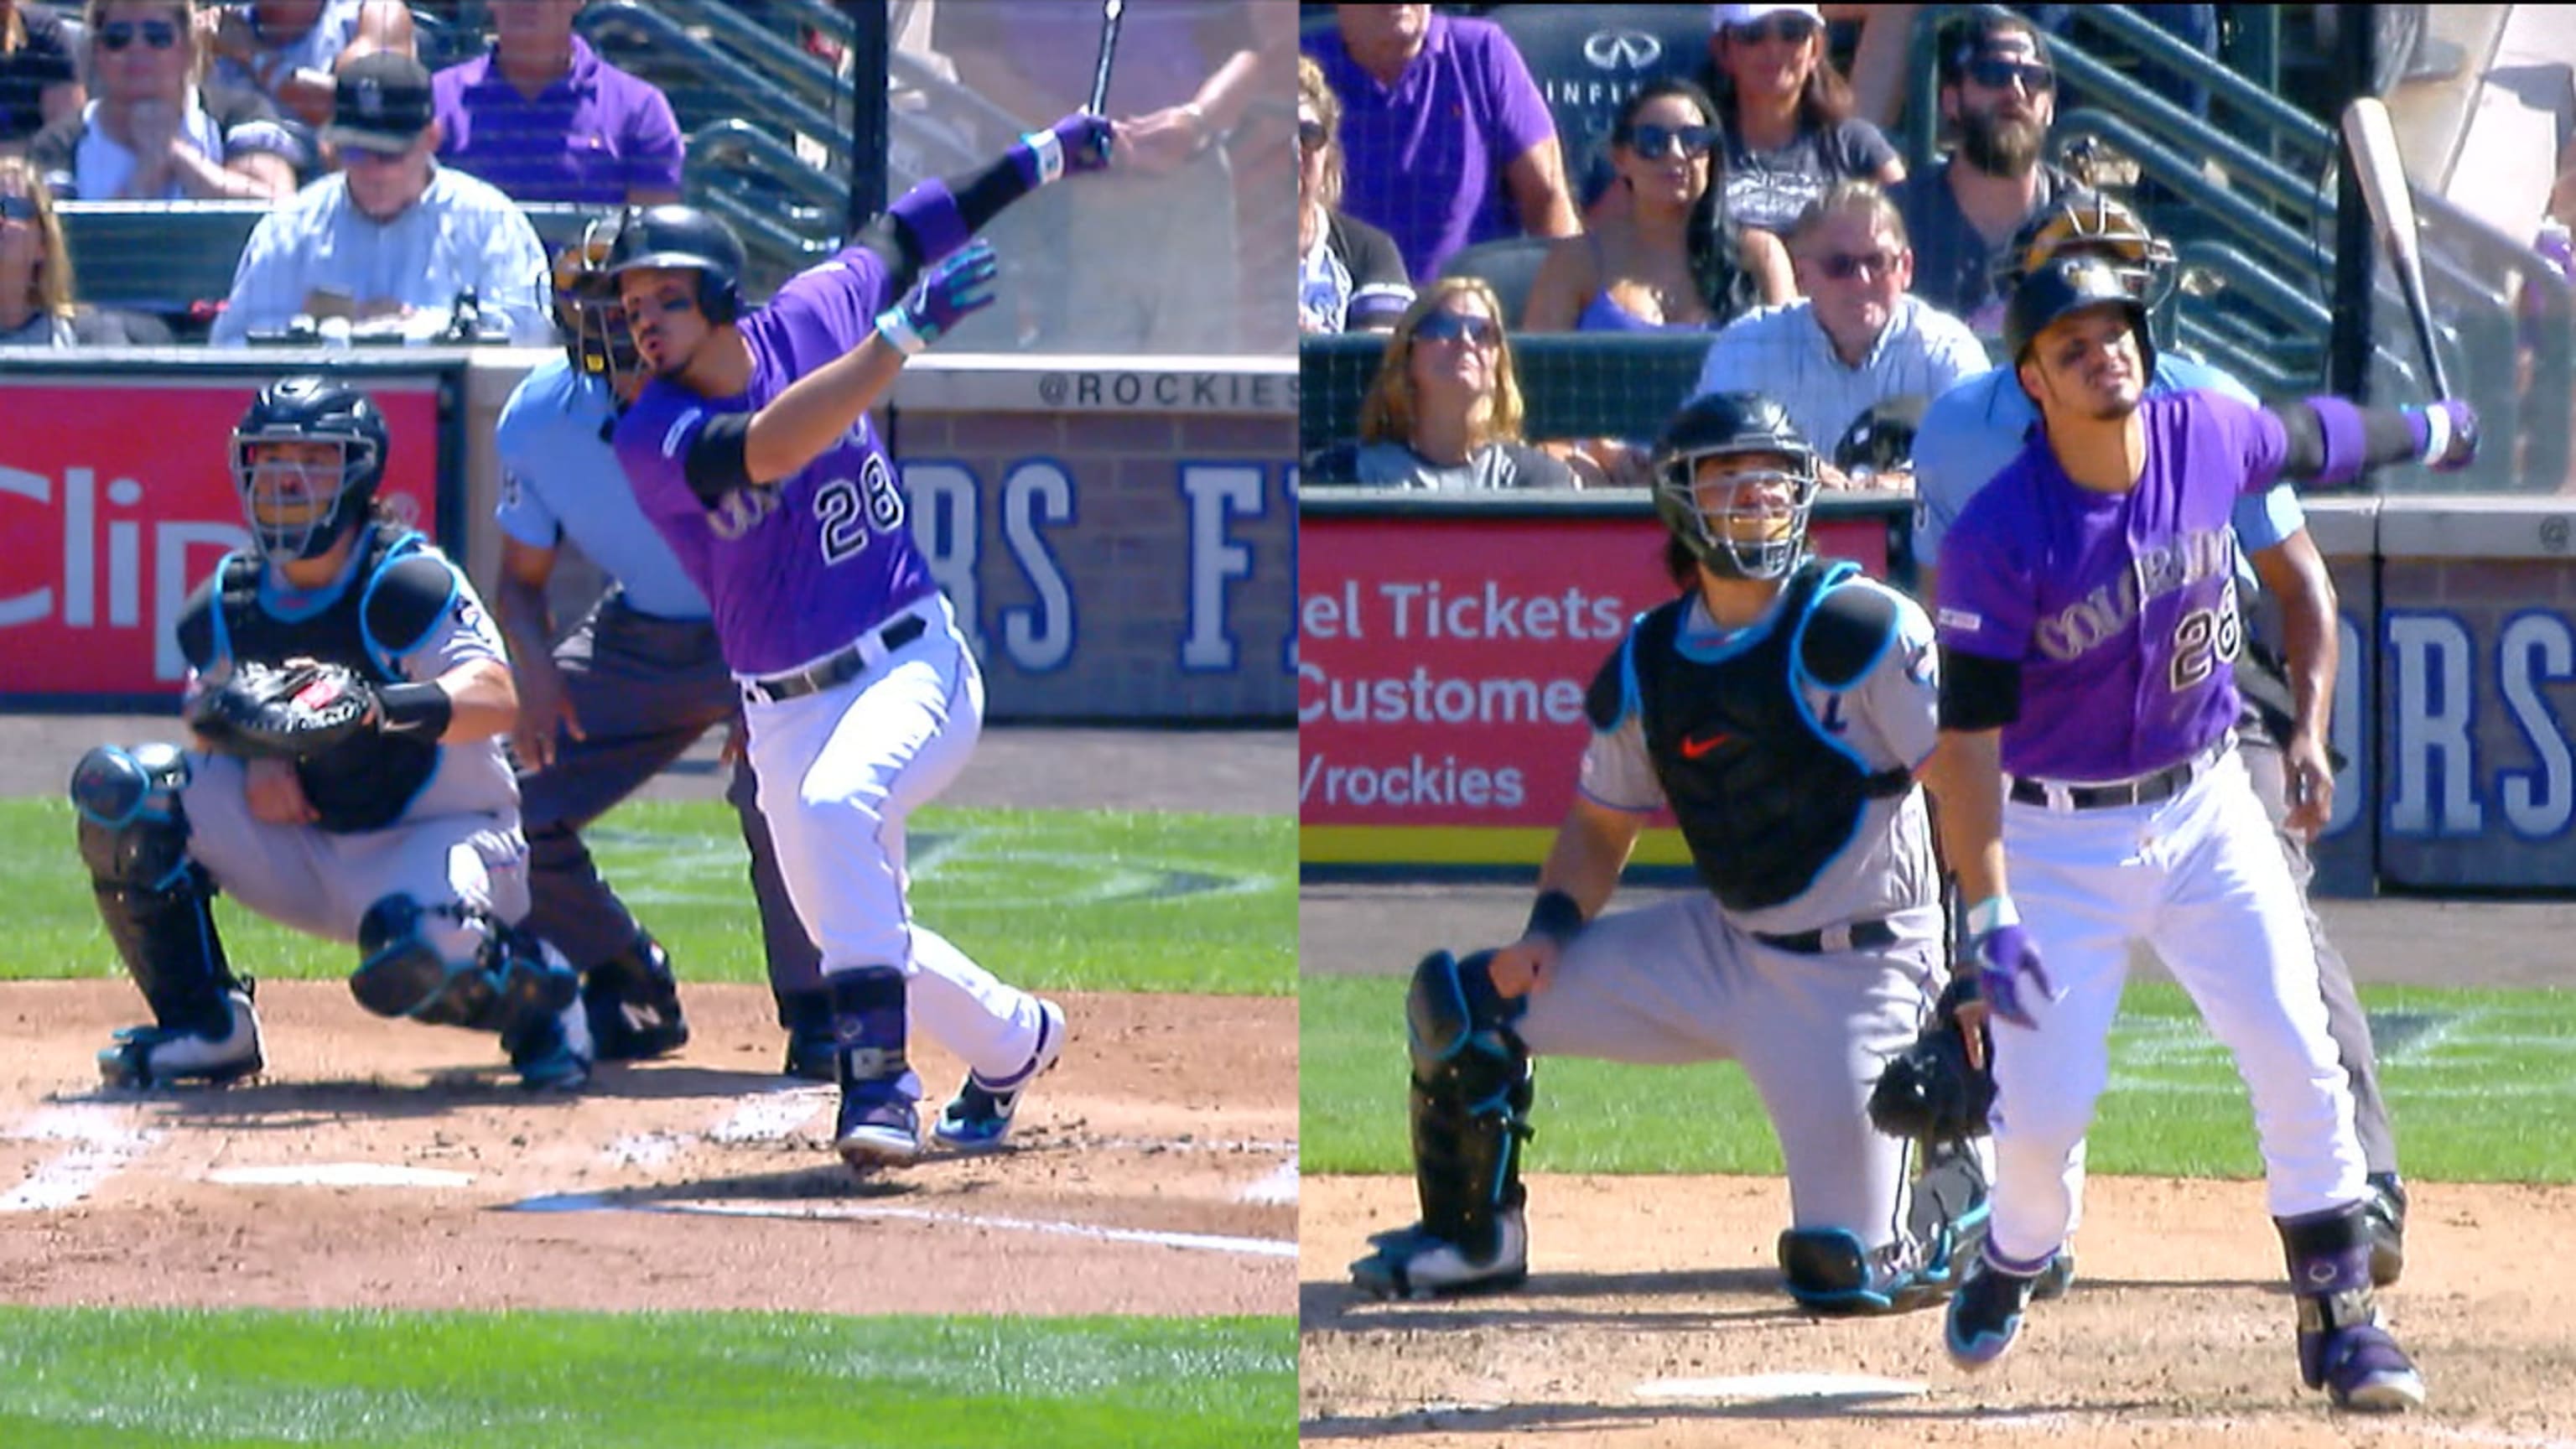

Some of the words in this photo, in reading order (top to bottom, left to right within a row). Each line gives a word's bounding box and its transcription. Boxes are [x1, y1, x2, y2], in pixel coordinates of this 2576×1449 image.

[813, 451, 904, 566] 28
[1183, 466, 1299, 669] F
[1301, 580, 1363, 638] el
[1379, 580, 1623, 639] Tickets
[2170, 577, 2241, 693] 28
[1300, 756, 1524, 806] /rockies
